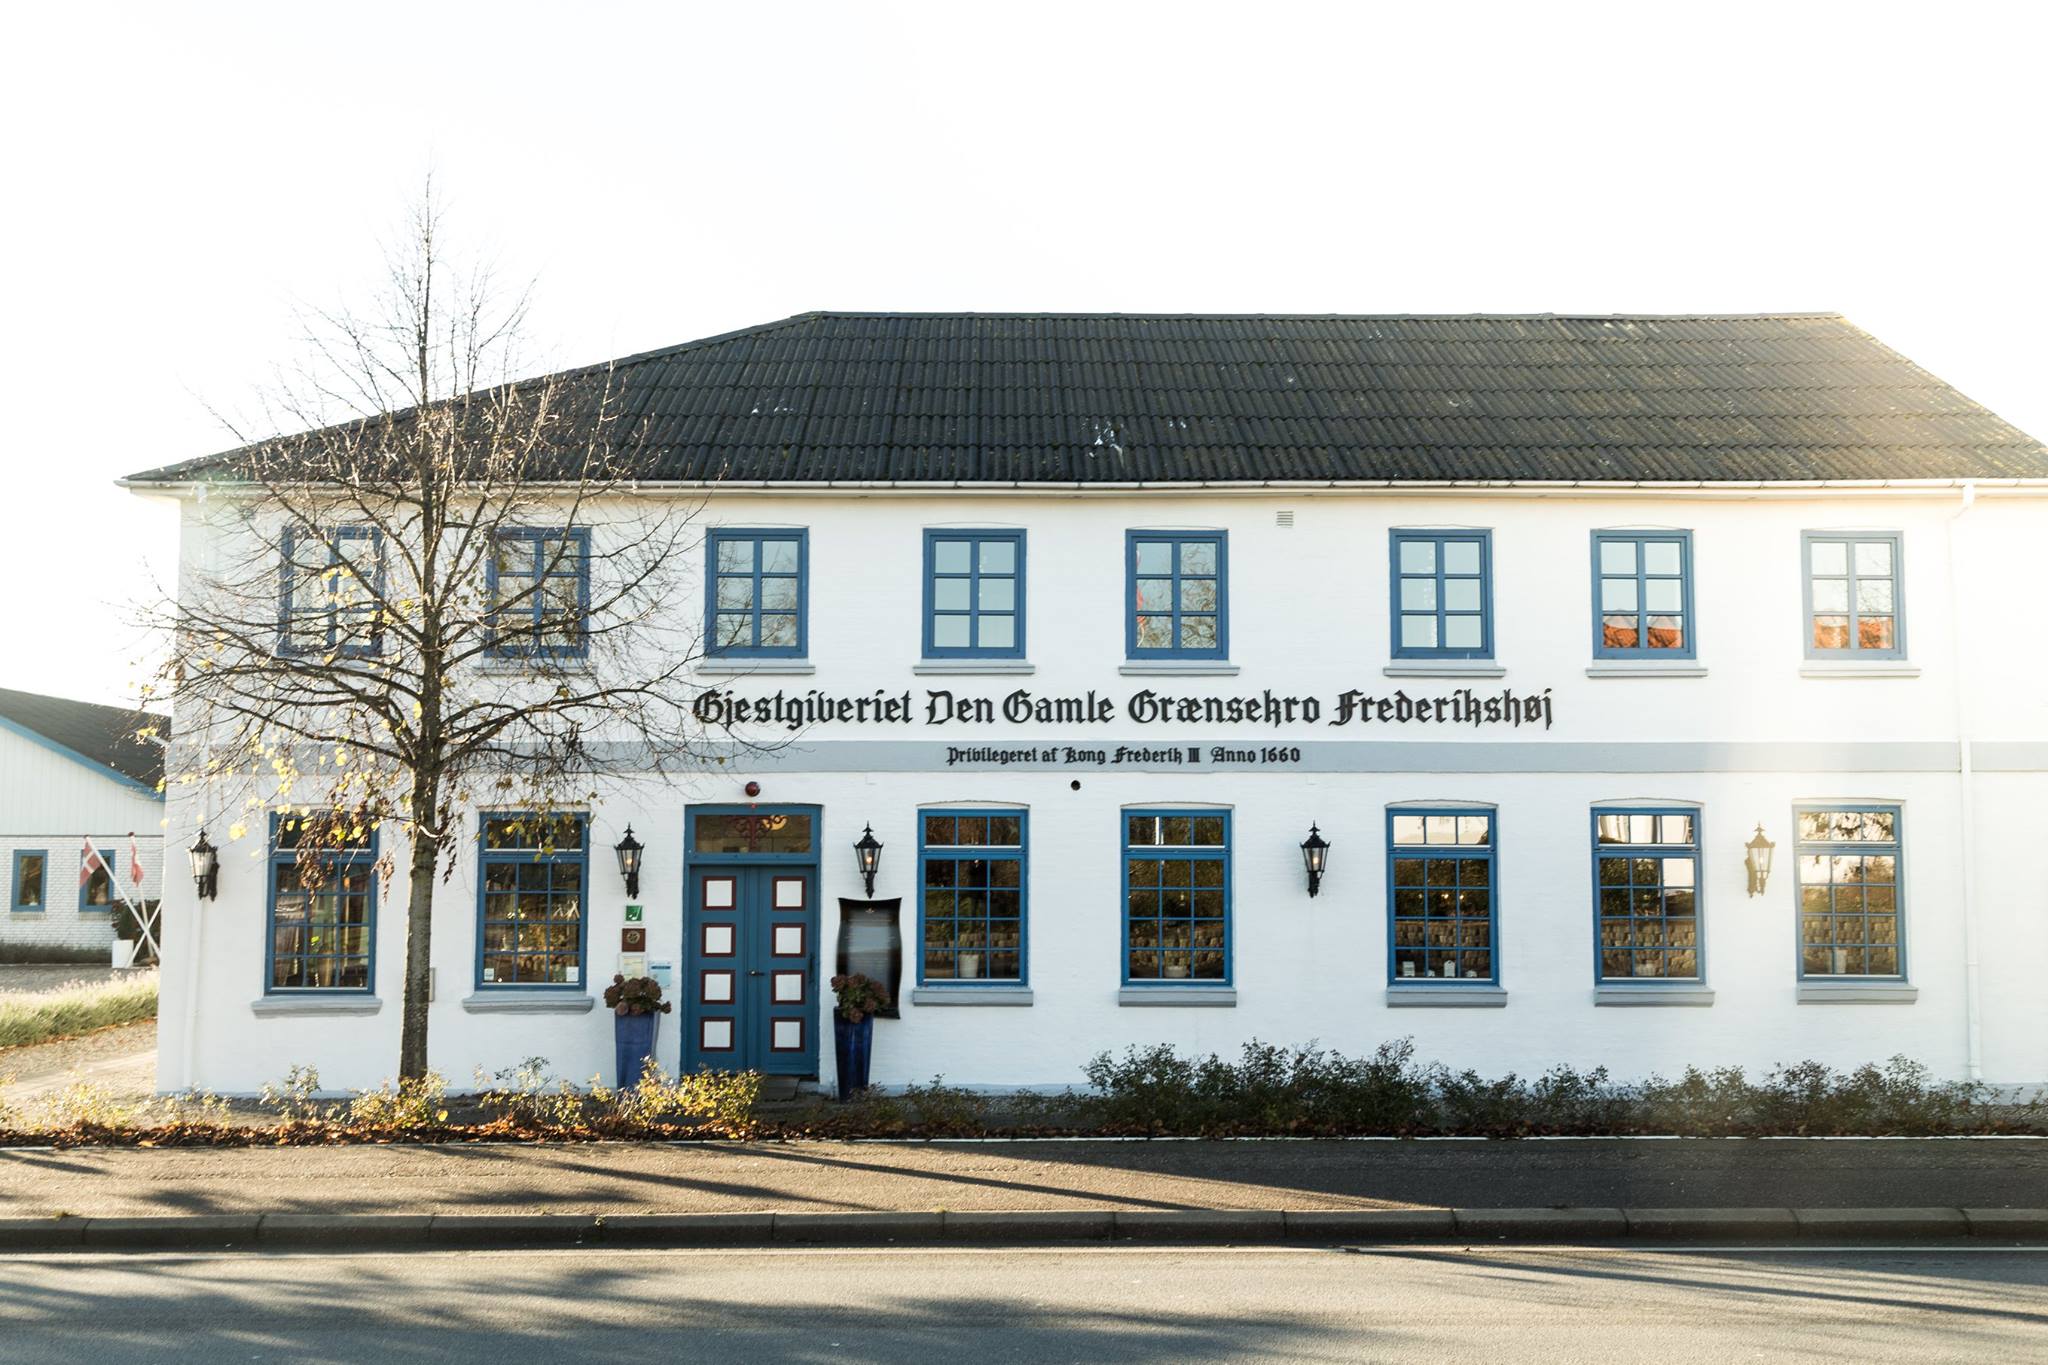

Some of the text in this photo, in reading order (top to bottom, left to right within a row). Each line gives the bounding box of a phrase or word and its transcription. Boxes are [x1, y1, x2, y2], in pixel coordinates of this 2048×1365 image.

[692, 688, 1553, 731] Gjestgiveriet Den Gamle Grænsekro Frederikshøj
[946, 746, 1037, 766] Privilegeret
[1042, 747, 1057, 763] af
[1061, 746, 1106, 765] Kong
[1111, 746, 1183, 765] Frederik
[1210, 746, 1256, 763] Anno
[1260, 746, 1301, 764] 1660
